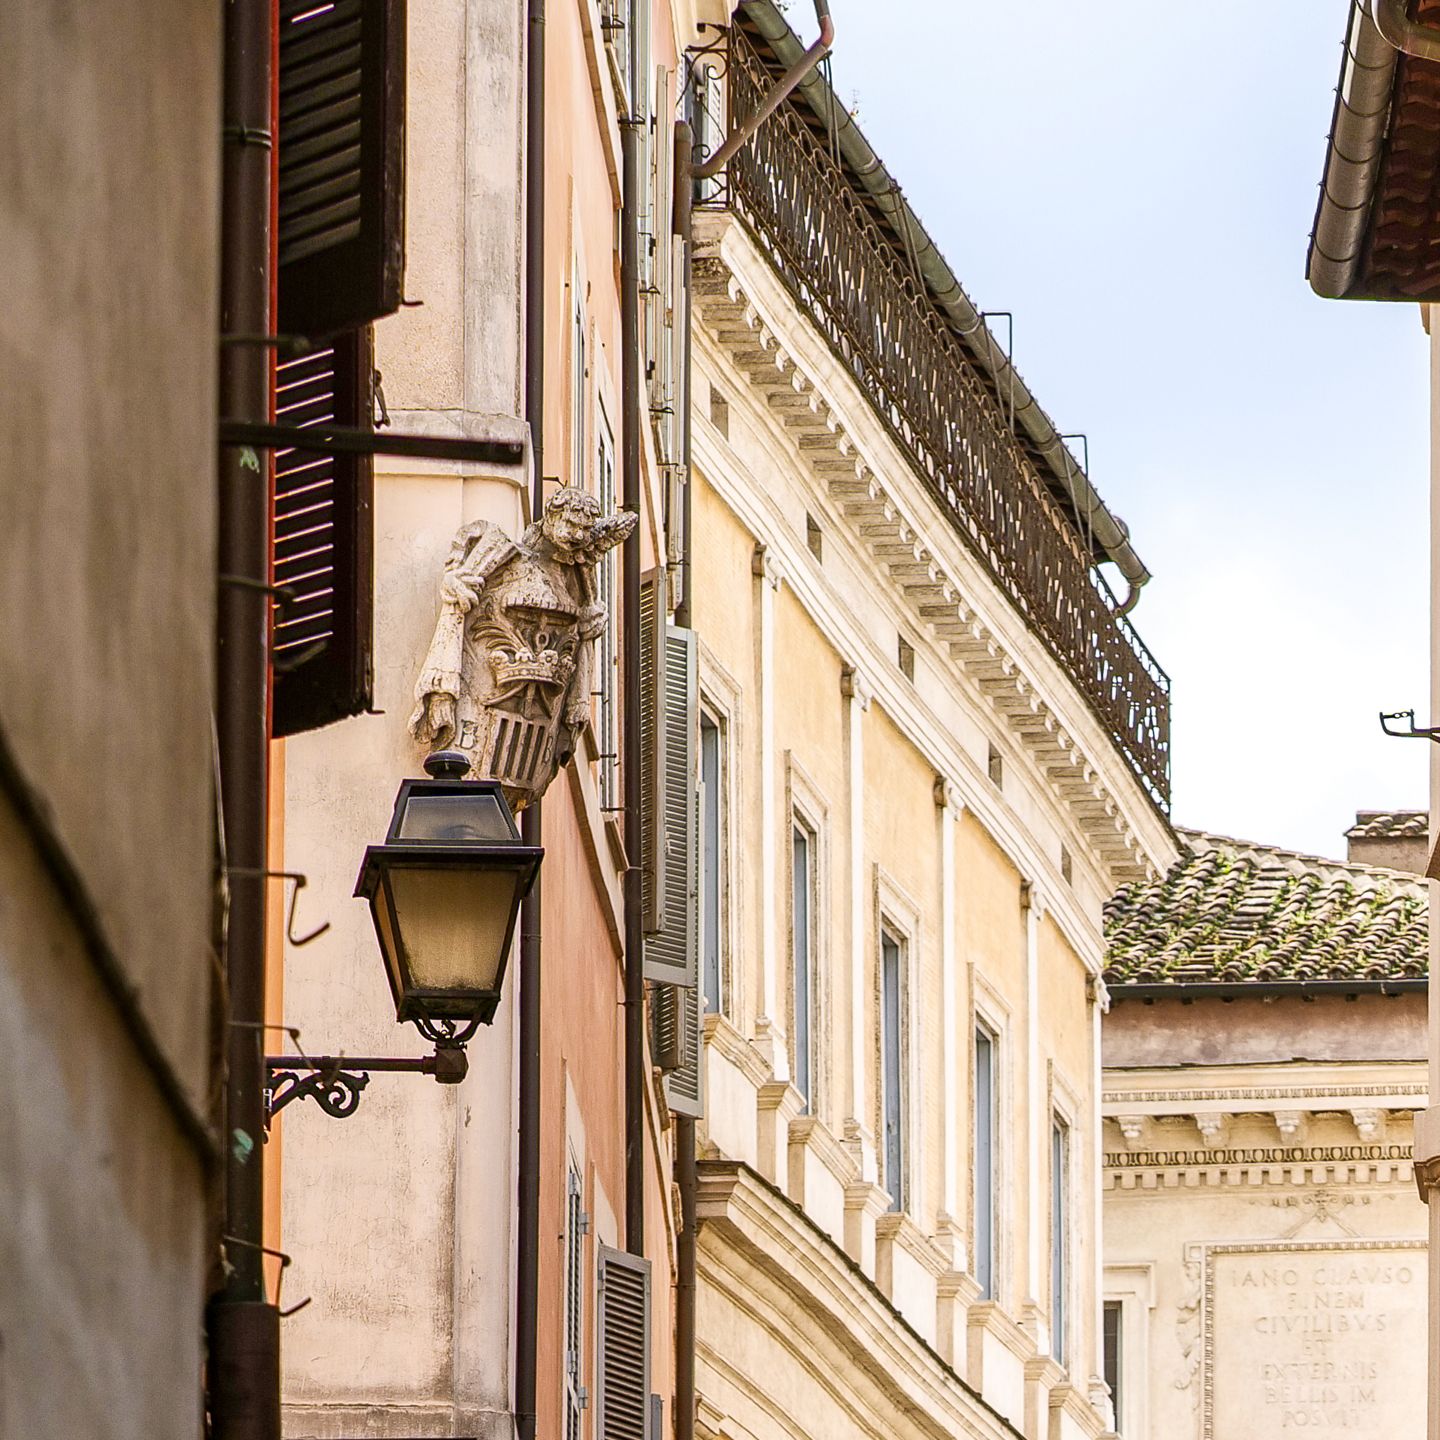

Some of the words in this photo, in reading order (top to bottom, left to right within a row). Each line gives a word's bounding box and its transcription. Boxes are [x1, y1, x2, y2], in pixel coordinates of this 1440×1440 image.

[1231, 1268, 1299, 1288] IANO
[1312, 1266, 1414, 1287] CLAVSO
[1253, 1313, 1388, 1334] CIVILIBVS
[1303, 1337, 1334, 1357] ET
[1261, 1360, 1379, 1381] EXTERNIS
[1264, 1385, 1339, 1405] BELLIS
[1350, 1385, 1377, 1404] IM
